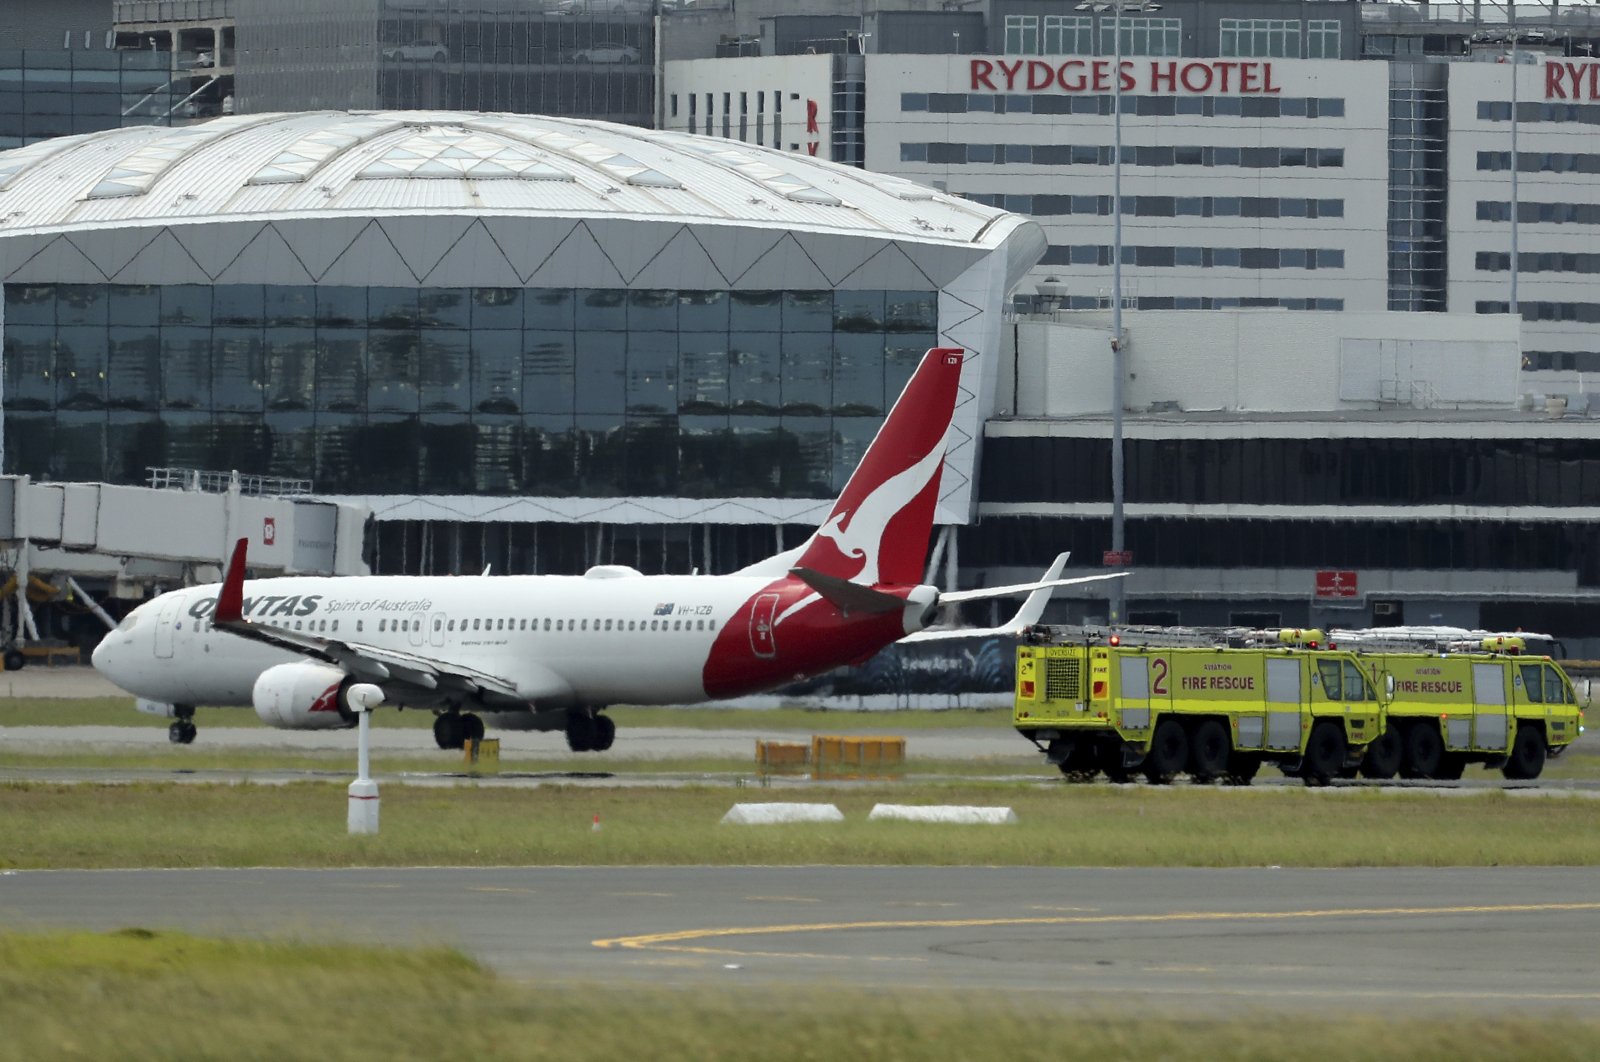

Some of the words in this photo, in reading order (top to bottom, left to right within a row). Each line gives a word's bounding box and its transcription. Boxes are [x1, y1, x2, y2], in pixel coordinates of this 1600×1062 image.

[970, 59, 1136, 92] RYDGES
[1150, 61, 1282, 94] HOTEL
[188, 595, 323, 618] QNTAS
[324, 599, 360, 614] Spirit
[360, 599, 381, 611] of
[375, 599, 432, 611] Australia
[677, 605, 713, 616] VH-XZB
[1050, 649, 1076, 657] OVERSIZE
[1021, 665, 1027, 675] 2
[1152, 658, 1168, 694] 2
[1182, 677, 1207, 690] FIRE
[1210, 677, 1254, 690] RESCUE
[1396, 681, 1418, 692] FIRE
[1421, 681, 1462, 693] RESCUE
